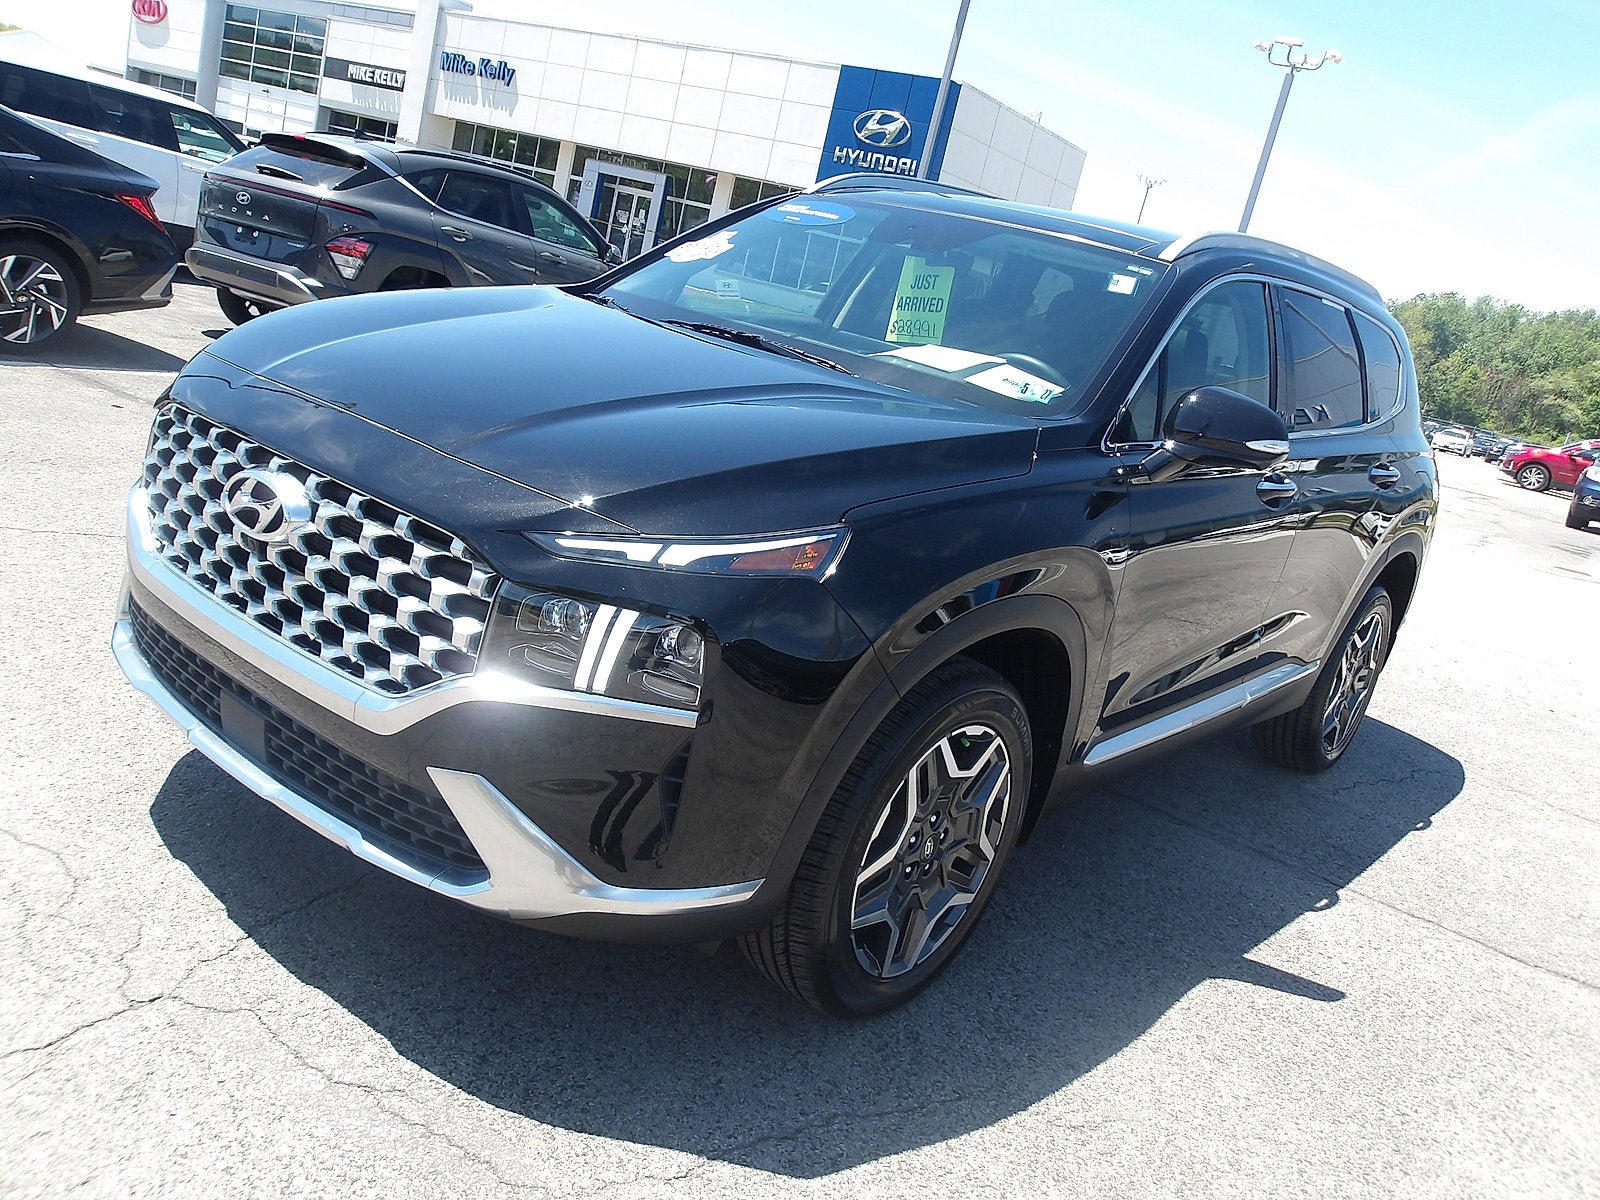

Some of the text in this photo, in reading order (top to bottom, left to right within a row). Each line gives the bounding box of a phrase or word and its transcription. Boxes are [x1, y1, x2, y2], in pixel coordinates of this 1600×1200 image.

[347, 64, 405, 88] MIKE KELLY
[440, 51, 516, 87] Mike Kelly
[833, 145, 918, 175] HYUNDAI
[218, 203, 271, 221] KONA
[910, 274, 939, 290] JUST
[896, 297, 944, 313] ARRIVED
[890, 318, 938, 338] $28,991
[1020, 382, 1031, 394] 5
[1040, 389, 1052, 400] 27
